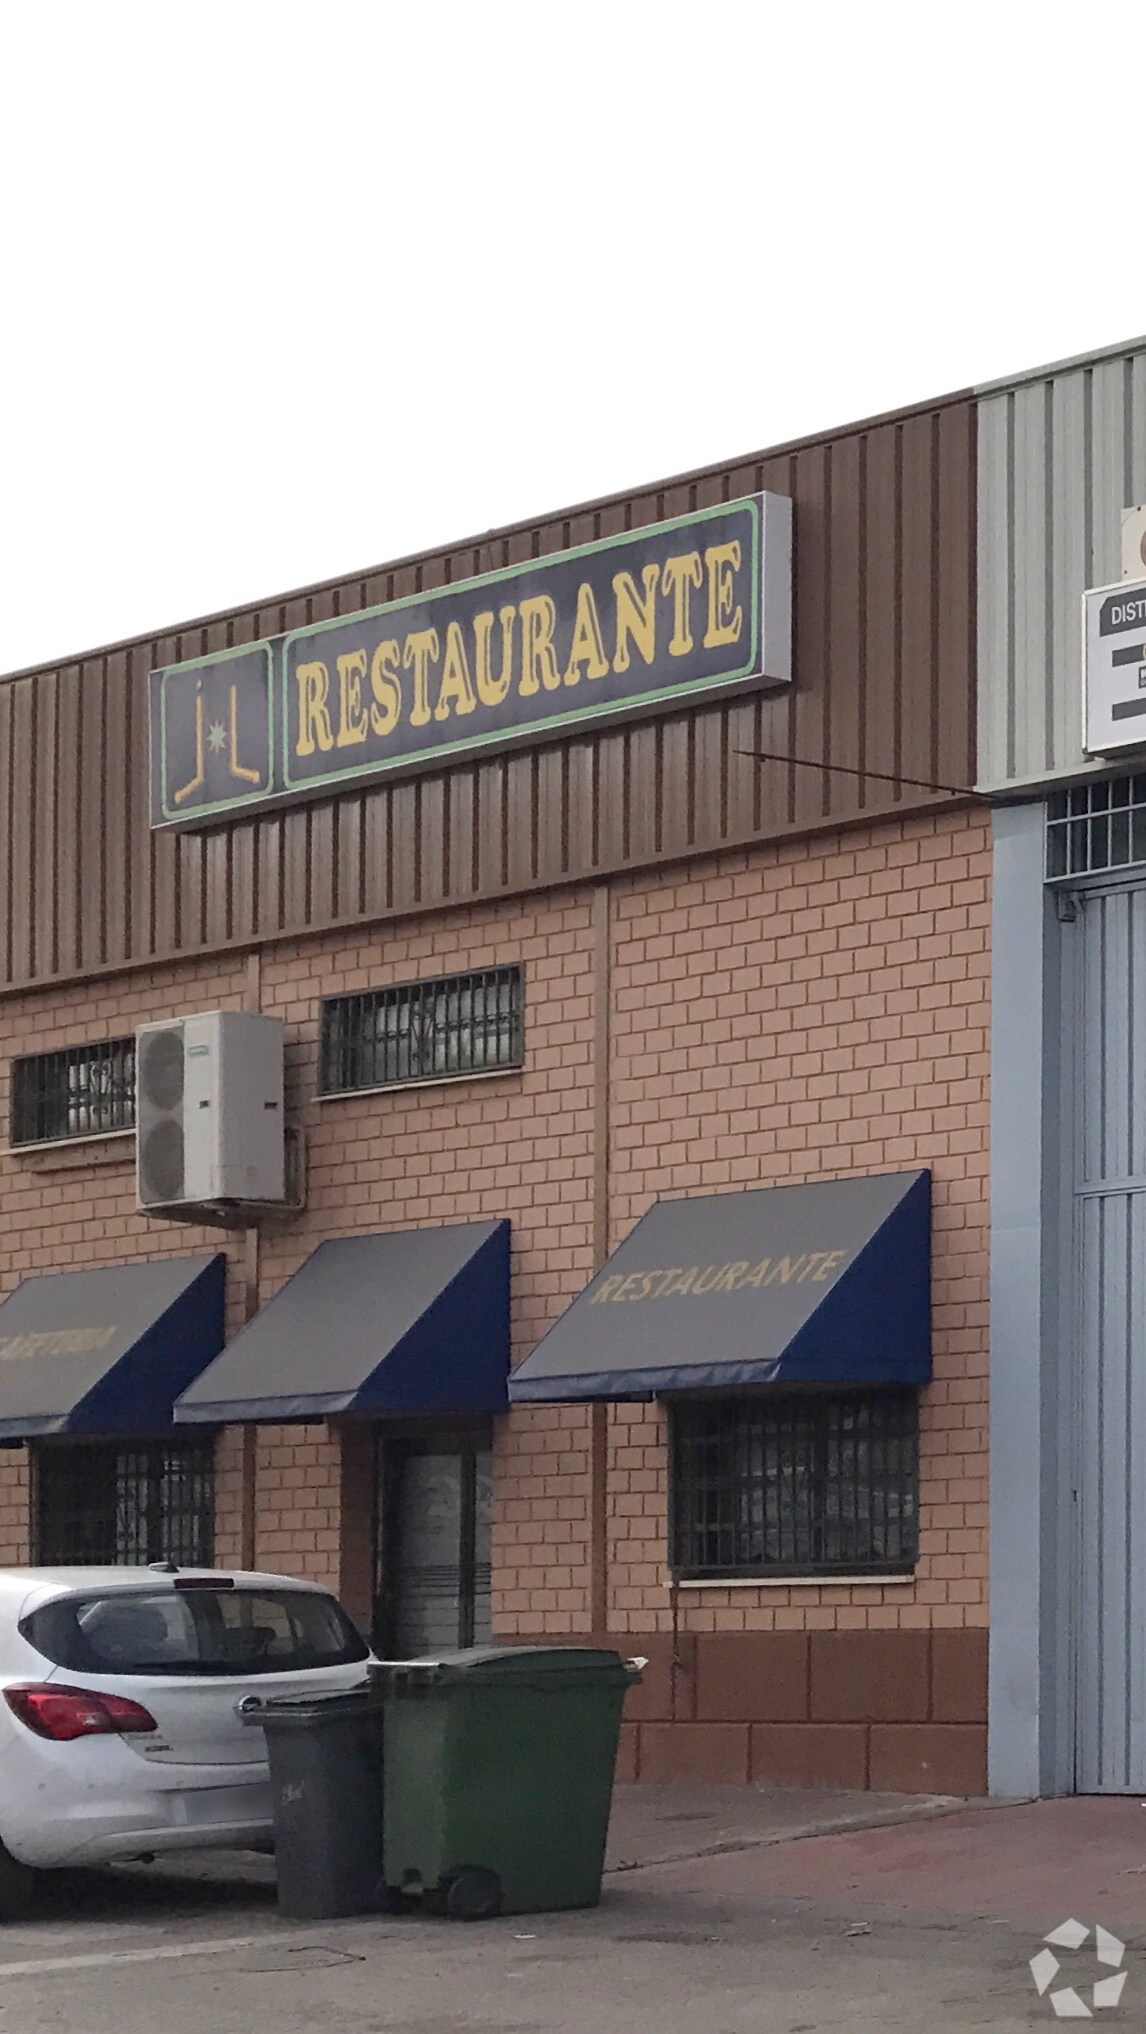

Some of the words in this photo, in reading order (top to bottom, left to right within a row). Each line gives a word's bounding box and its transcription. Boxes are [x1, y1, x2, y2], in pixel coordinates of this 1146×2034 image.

[1111, 599, 1146, 625] DIST
[295, 539, 743, 756] RESTAURANTE
[590, 1250, 847, 1303] RESTAURANTE
